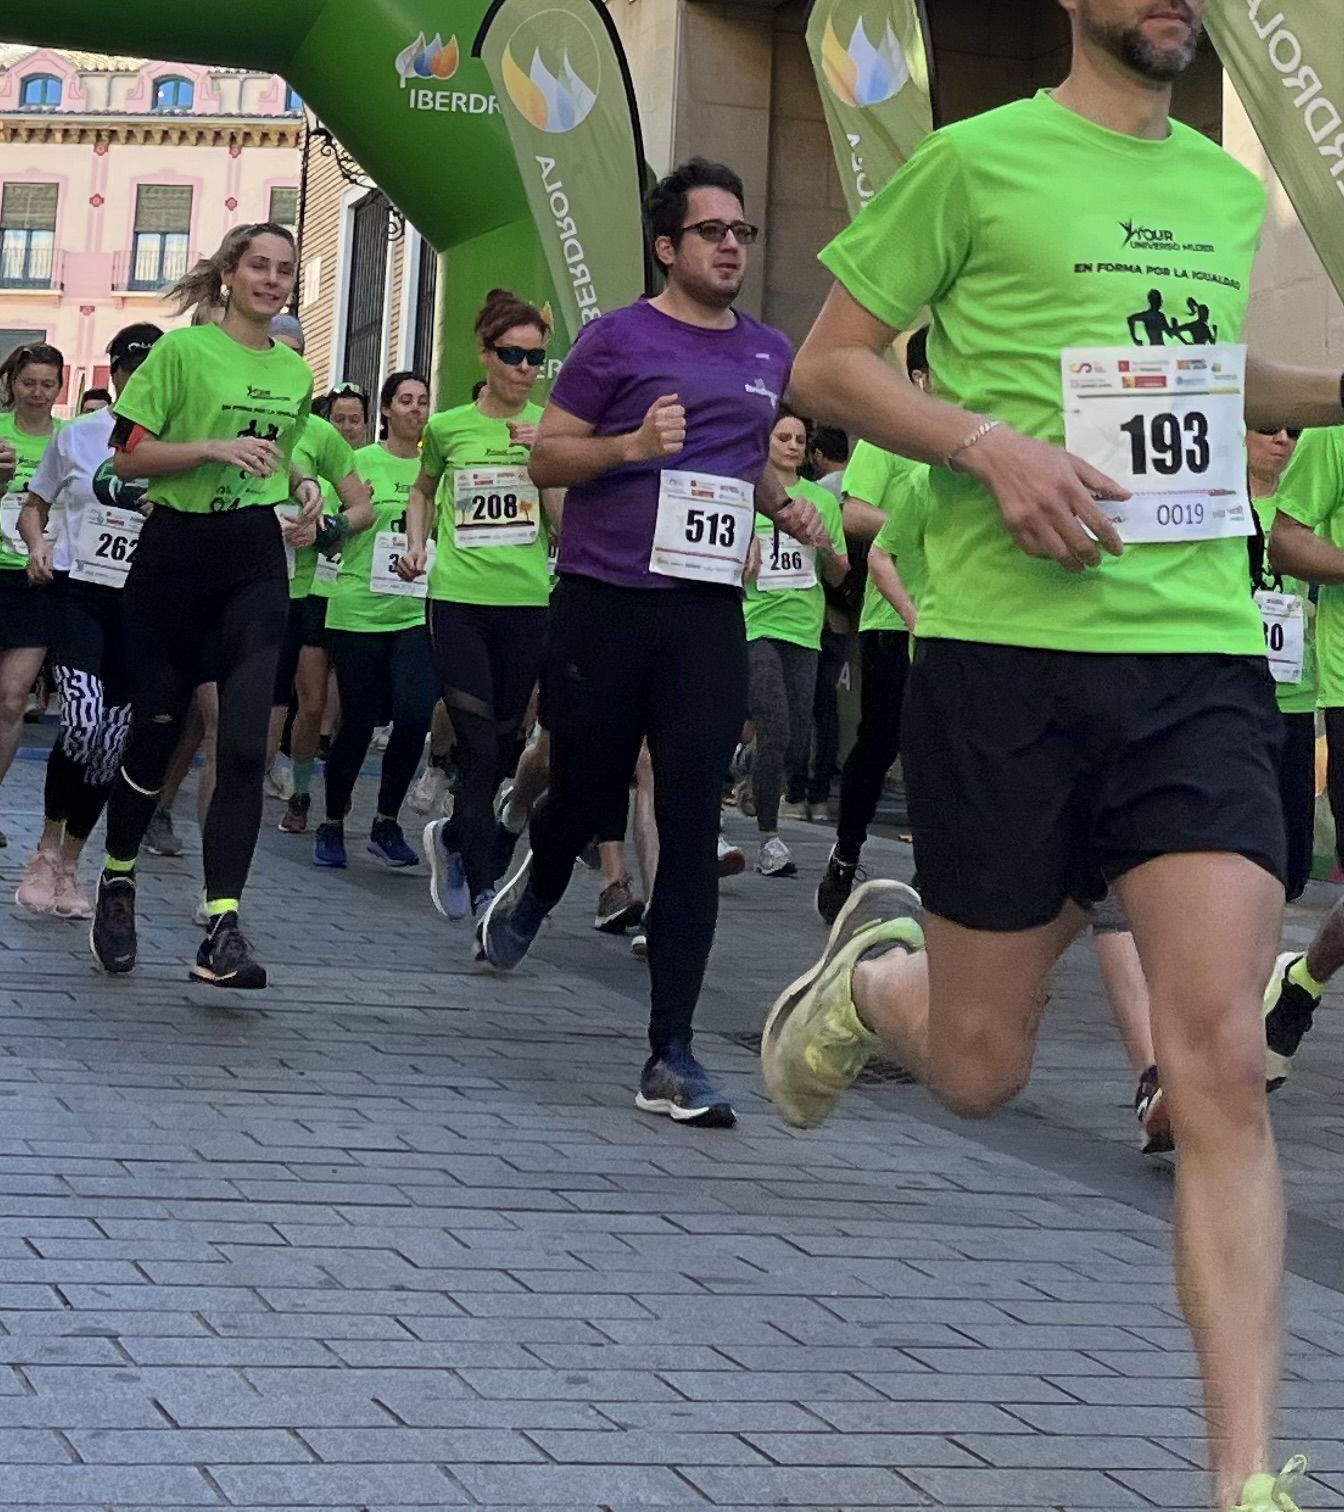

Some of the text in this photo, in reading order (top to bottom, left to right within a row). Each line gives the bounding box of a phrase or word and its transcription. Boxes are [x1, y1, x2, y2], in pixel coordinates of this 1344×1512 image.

[1174, 267, 1190, 279] LA
[1120, 410, 1211, 475] 193
[472, 493, 518, 520] 208
[1157, 502, 1205, 526] 0019
[685, 509, 736, 548] 513
[96, 532, 140, 564] 262
[769, 551, 802, 571] 286
